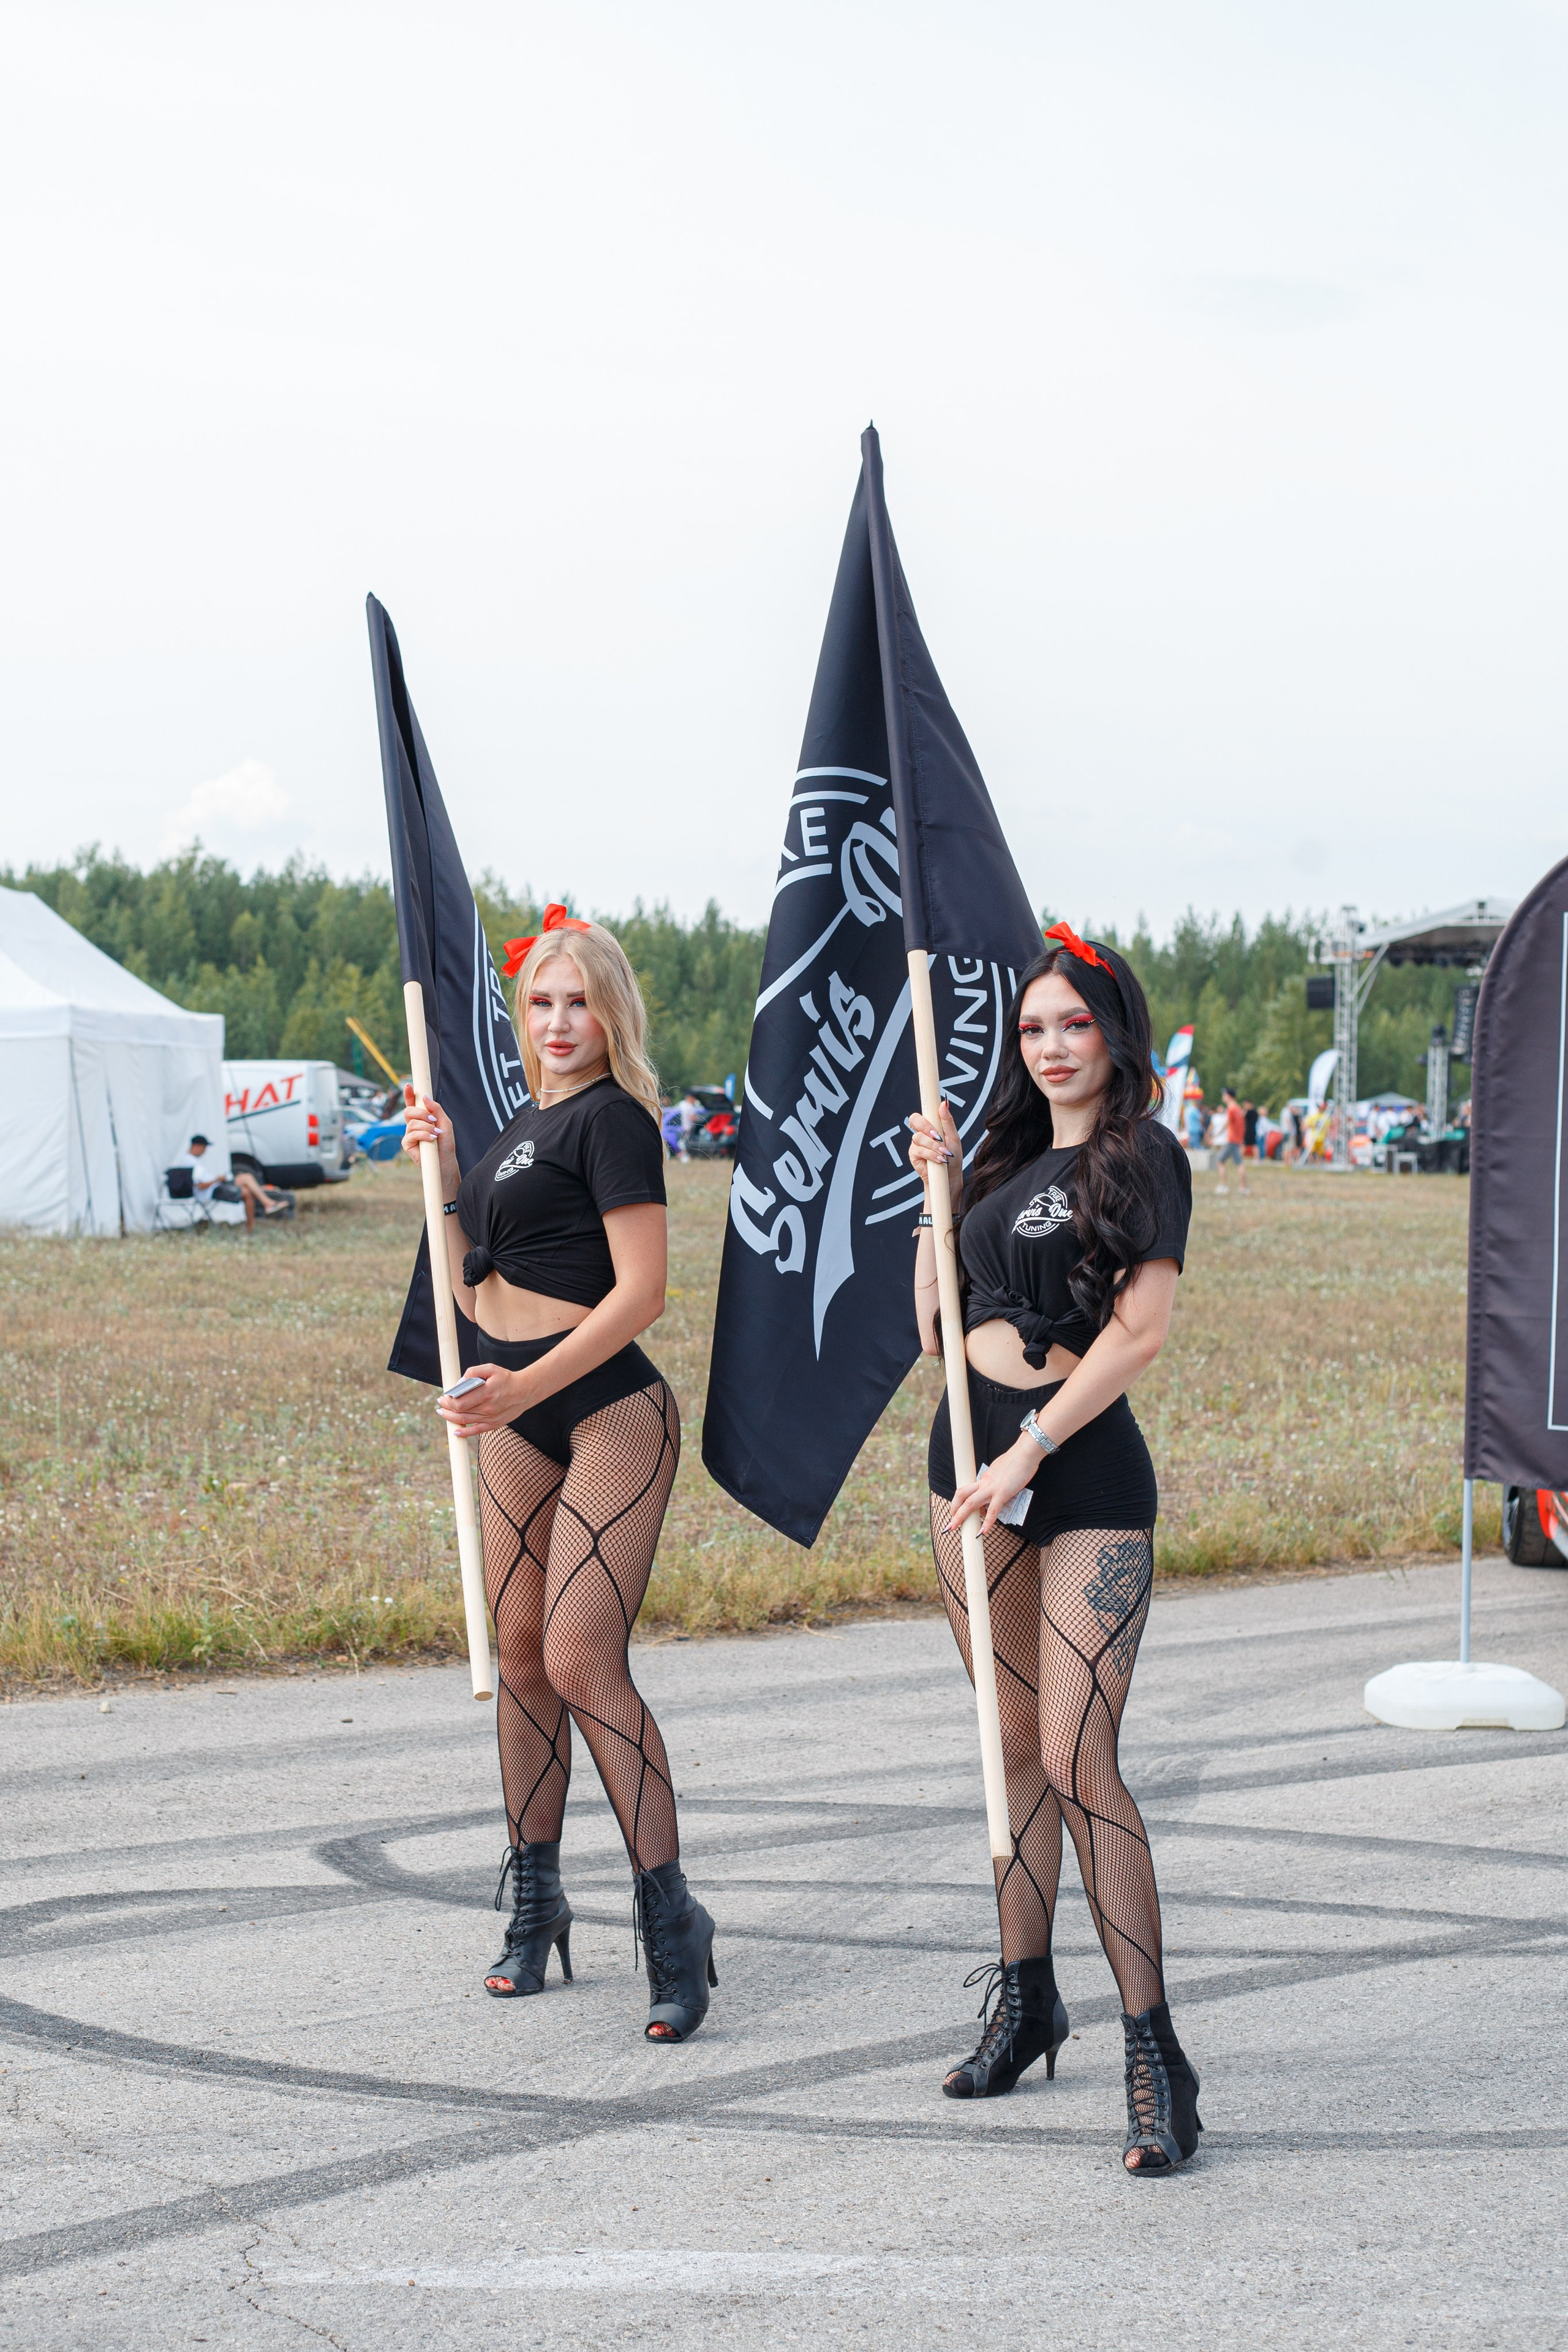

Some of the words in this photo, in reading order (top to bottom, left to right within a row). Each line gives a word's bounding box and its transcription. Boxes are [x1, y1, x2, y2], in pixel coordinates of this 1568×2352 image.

[225, 1074, 303, 1117] HAT
[731, 971, 875, 1274] Servis
[869, 956, 988, 1168] TNING
[1022, 1221, 1052, 1232] TUNING
